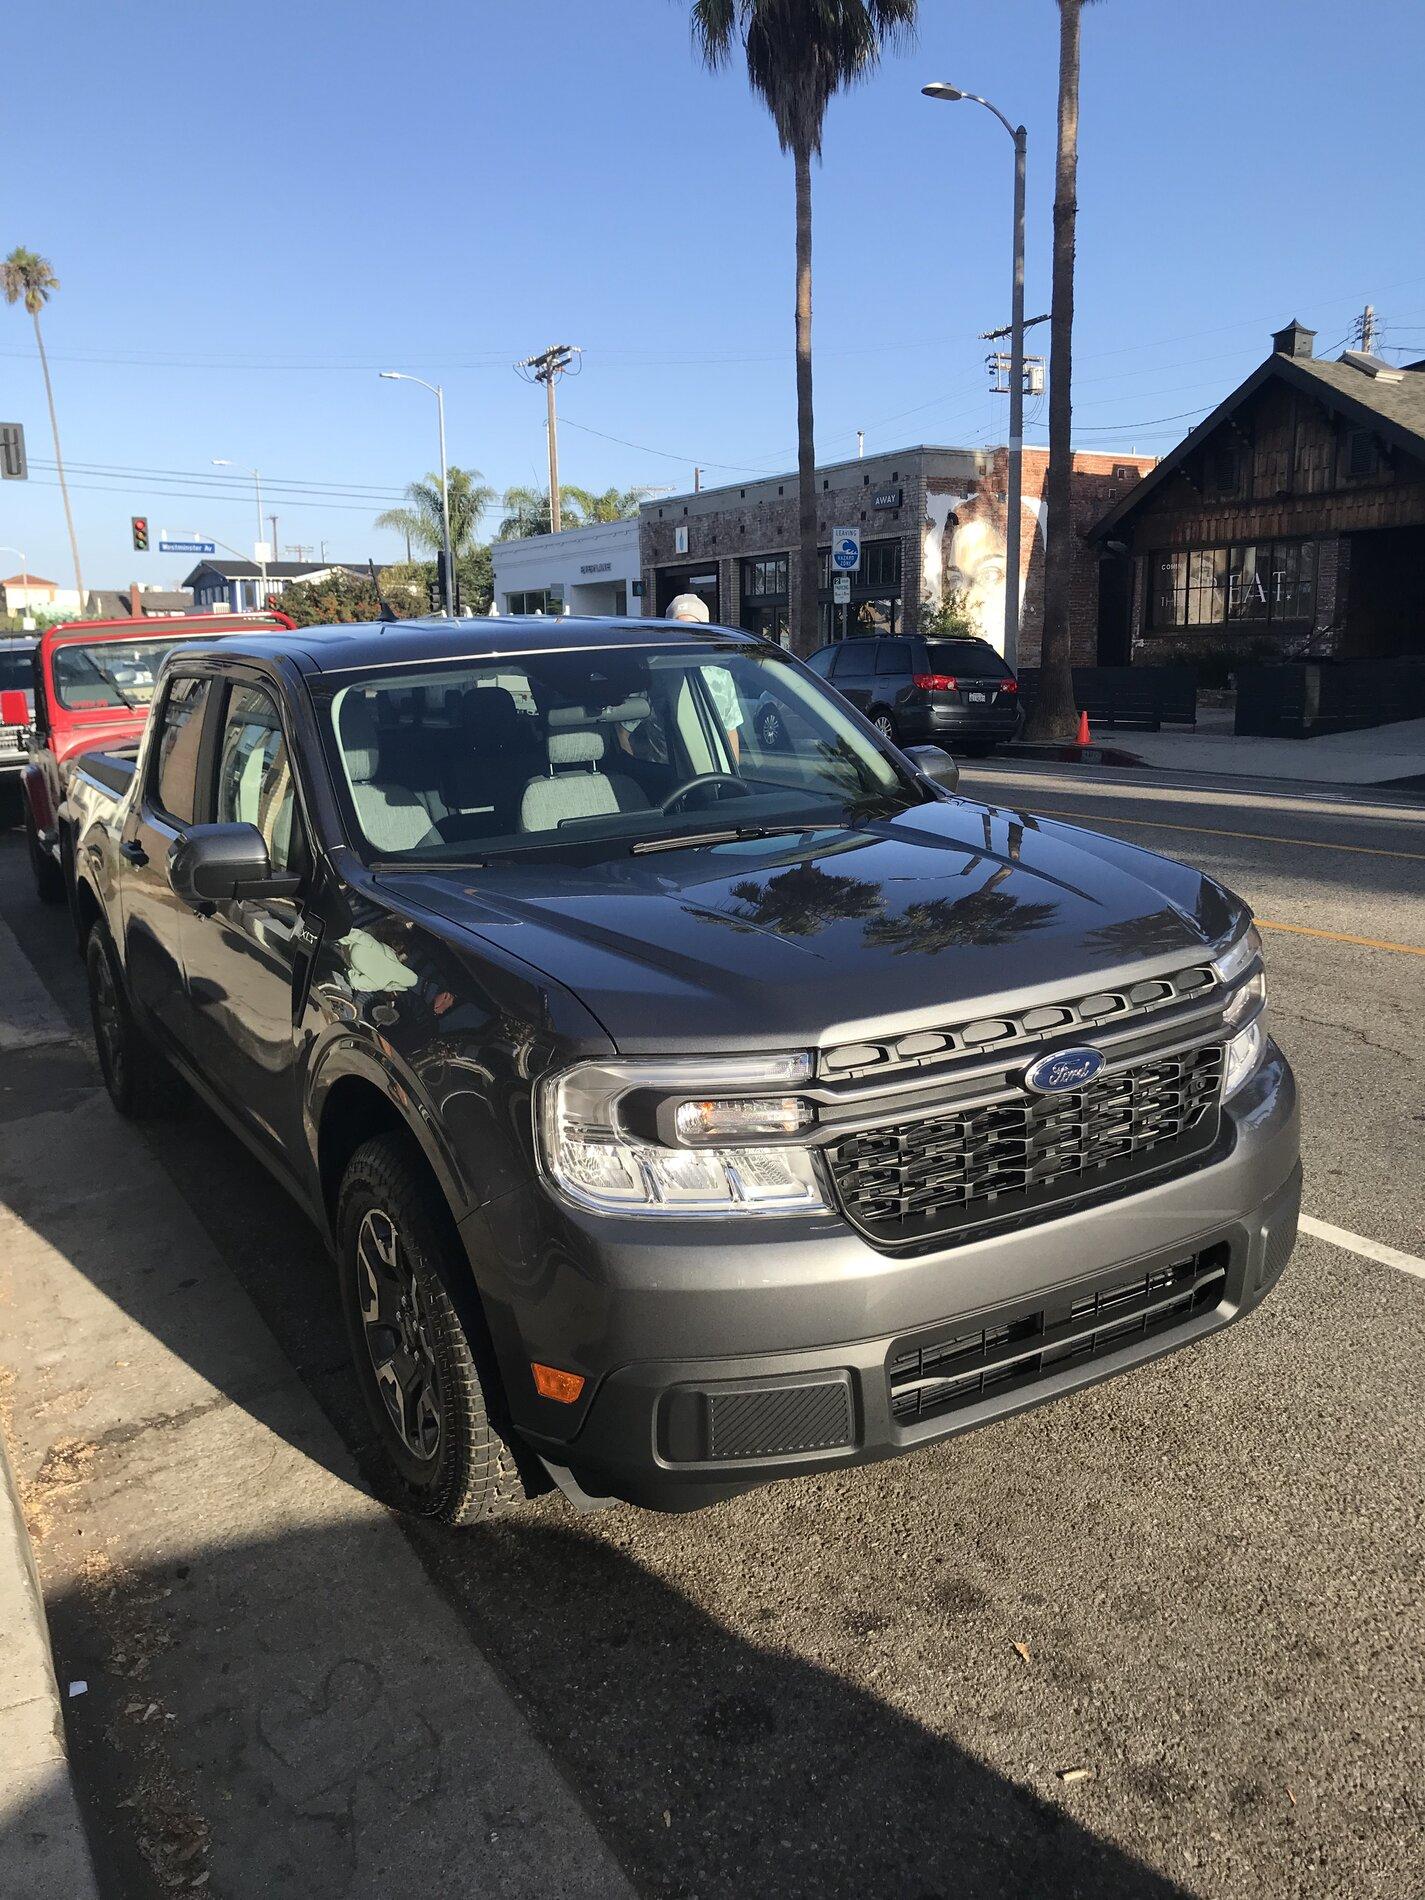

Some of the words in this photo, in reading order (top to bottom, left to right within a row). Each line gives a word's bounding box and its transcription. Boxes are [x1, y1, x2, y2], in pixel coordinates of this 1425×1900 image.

[875, 494, 896, 505] AWAY
[835, 529, 857, 537] LEAVING
[162, 543, 202, 551] Westminster
[301, 930, 318, 944] XLT
[1048, 1058, 1090, 1086] Ford
